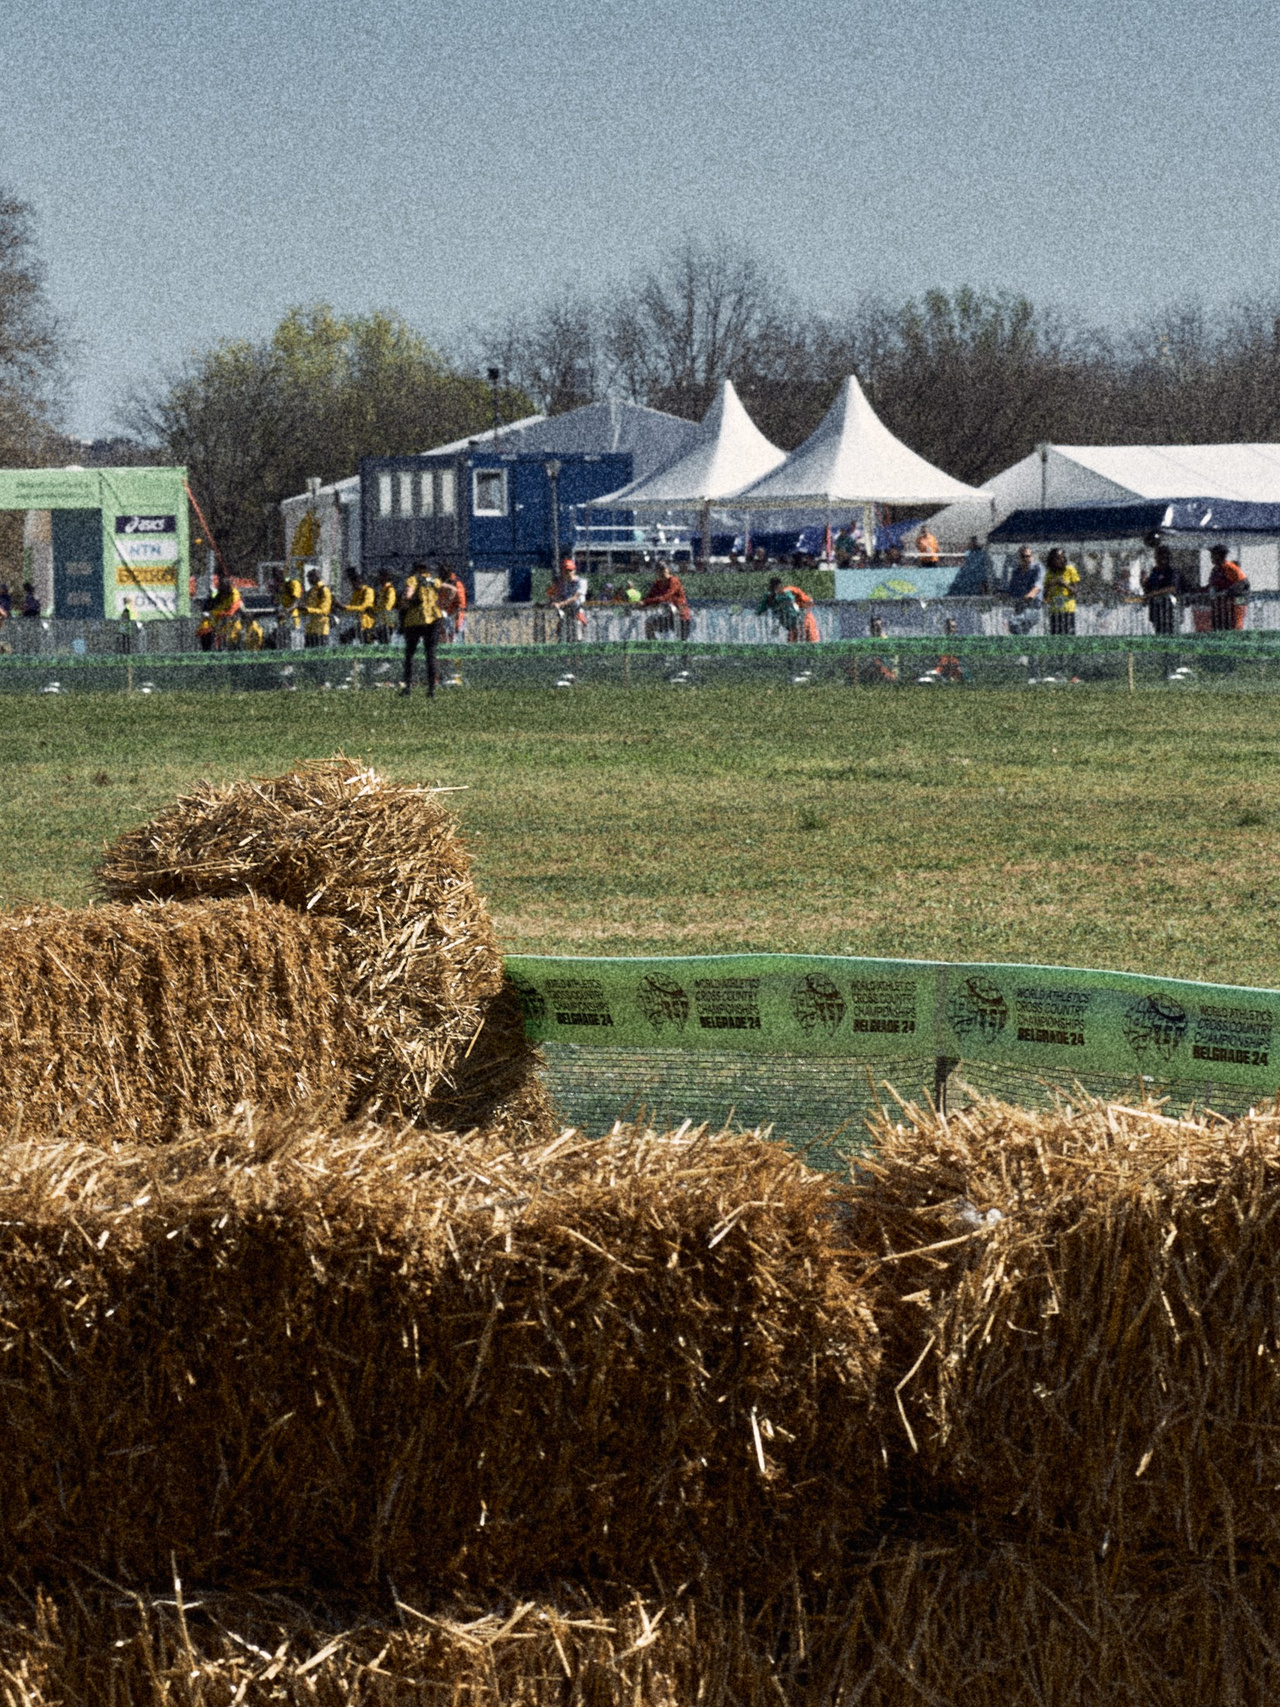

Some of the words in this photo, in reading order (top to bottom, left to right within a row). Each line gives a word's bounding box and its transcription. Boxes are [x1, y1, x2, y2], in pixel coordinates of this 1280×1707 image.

[1017, 988, 1044, 999] WORLD
[1047, 990, 1091, 1003] ATHLETICS
[1016, 1000, 1043, 1013] CROSS
[1045, 1002, 1088, 1015] COUNTRY
[1200, 1005, 1228, 1018] WORLD
[1229, 1008, 1273, 1021] ATHLETICS
[853, 1019, 899, 1033] BELGRADE
[901, 1020, 915, 1034] 24
[1017, 1013, 1085, 1031] CHAMPIONSHIPS
[1198, 1018, 1228, 1032] CROSS
[1230, 1021, 1272, 1035] COUNTRY
[1017, 1027, 1069, 1044] BELGRADE
[1070, 1032, 1085, 1046] 24
[1194, 1031, 1270, 1050] CHAMPIONSHIPS
[1192, 1045, 1250, 1065] BELGRADE
[1252, 1051, 1268, 1066] 24
